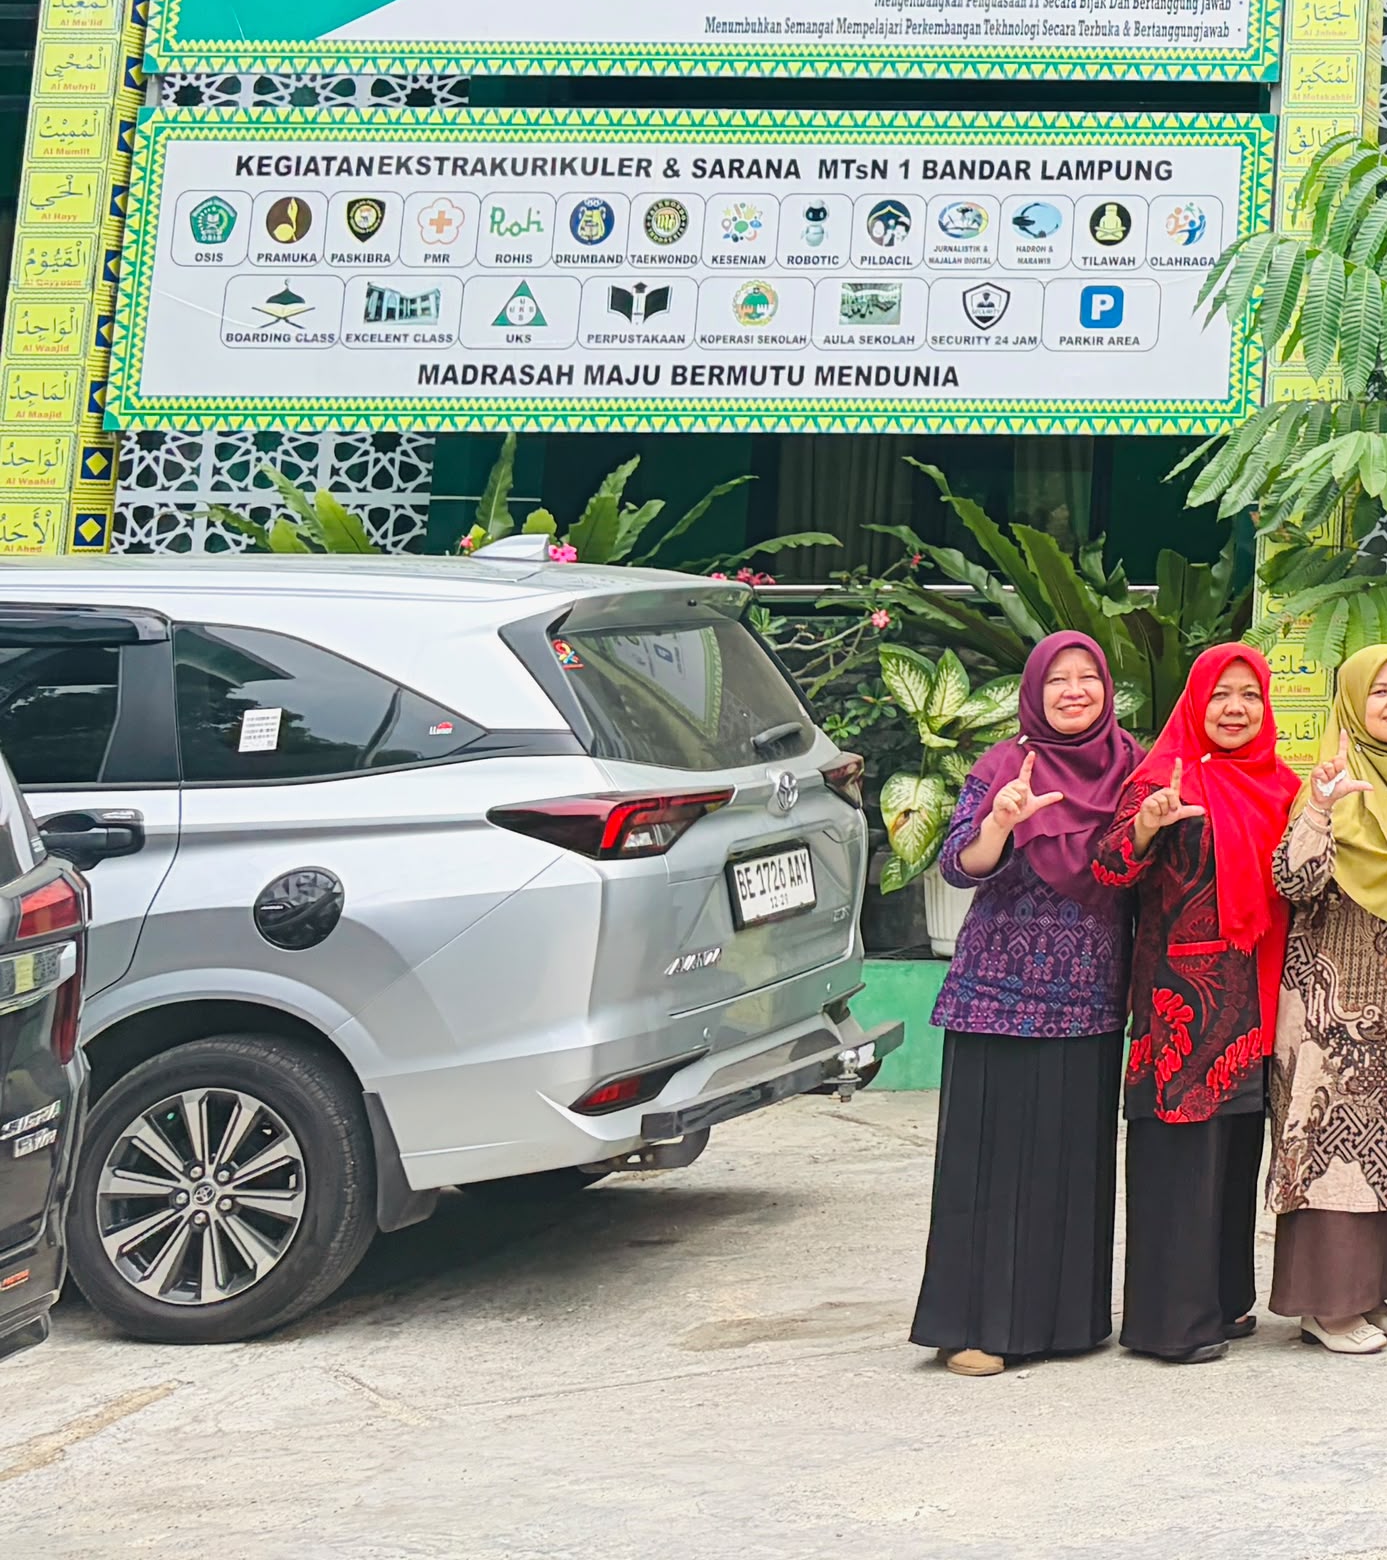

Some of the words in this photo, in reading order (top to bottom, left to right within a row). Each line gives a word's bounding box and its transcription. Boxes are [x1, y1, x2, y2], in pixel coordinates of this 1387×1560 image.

[704, 15, 782, 34] Menumbuhkan
[783, 16, 834, 39] Semangat
[835, 16, 903, 39] Mempelajari
[904, 17, 982, 40] Perkembangan
[983, 18, 1040, 41] Tekhnologi
[1041, 18, 1076, 37] Secara
[1077, 19, 1120, 37] Terbuka
[1133, 19, 1230, 43] Bertanggungjawab
[691, 157, 801, 179] SARANA
[817, 158, 888, 180] MTsN
[898, 158, 910, 180] 1
[921, 159, 1031, 181] BANDAR
[1040, 159, 1172, 181] LAMPUNG
[194, 252, 224, 263] OSIS
[256, 252, 318, 263] PRAMUKA
[331, 253, 392, 264] PASKIBRA
[424, 253, 451, 264] PMR
[495, 253, 533, 264] ROHIS
[555, 254, 624, 265] DRUMBAND
[630, 254, 698, 265] TAEKWONDO
[711, 255, 767, 265] KESENIAN
[787, 255, 840, 266] ROBOTIC
[860, 255, 913, 266] PILDACIL
[1082, 256, 1136, 267] TILAWAH
[1150, 256, 1216, 267] OLAHRAGA
[1091, 293, 1115, 320] P
[225, 332, 291, 343] BOARDING
[295, 333, 336, 343] CLASS
[345, 333, 410, 343] EXCELENT
[413, 333, 454, 344] CLASS
[506, 333, 533, 344] UKS
[587, 334, 686, 344] PERPUSTAKAAN
[700, 334, 754, 344] KOPERASI
[757, 334, 807, 345] SEKOLAH
[823, 335, 855, 345] AULA
[859, 335, 915, 345] SEKOLAH
[931, 335, 991, 346] SECURITY
[995, 336, 1009, 346] 24
[1012, 336, 1038, 346] JAM
[1059, 336, 1104, 346] PARKIR
[1107, 336, 1141, 346] AREA
[417, 363, 574, 386] MADRASAH
[583, 364, 661, 386] MAJU
[670, 364, 805, 386] BERMUTU
[814, 365, 959, 387] MENDUNIA
[736, 867, 756, 901] BE
[756, 860, 786, 896] 1726
[788, 852, 808, 888] AAY
